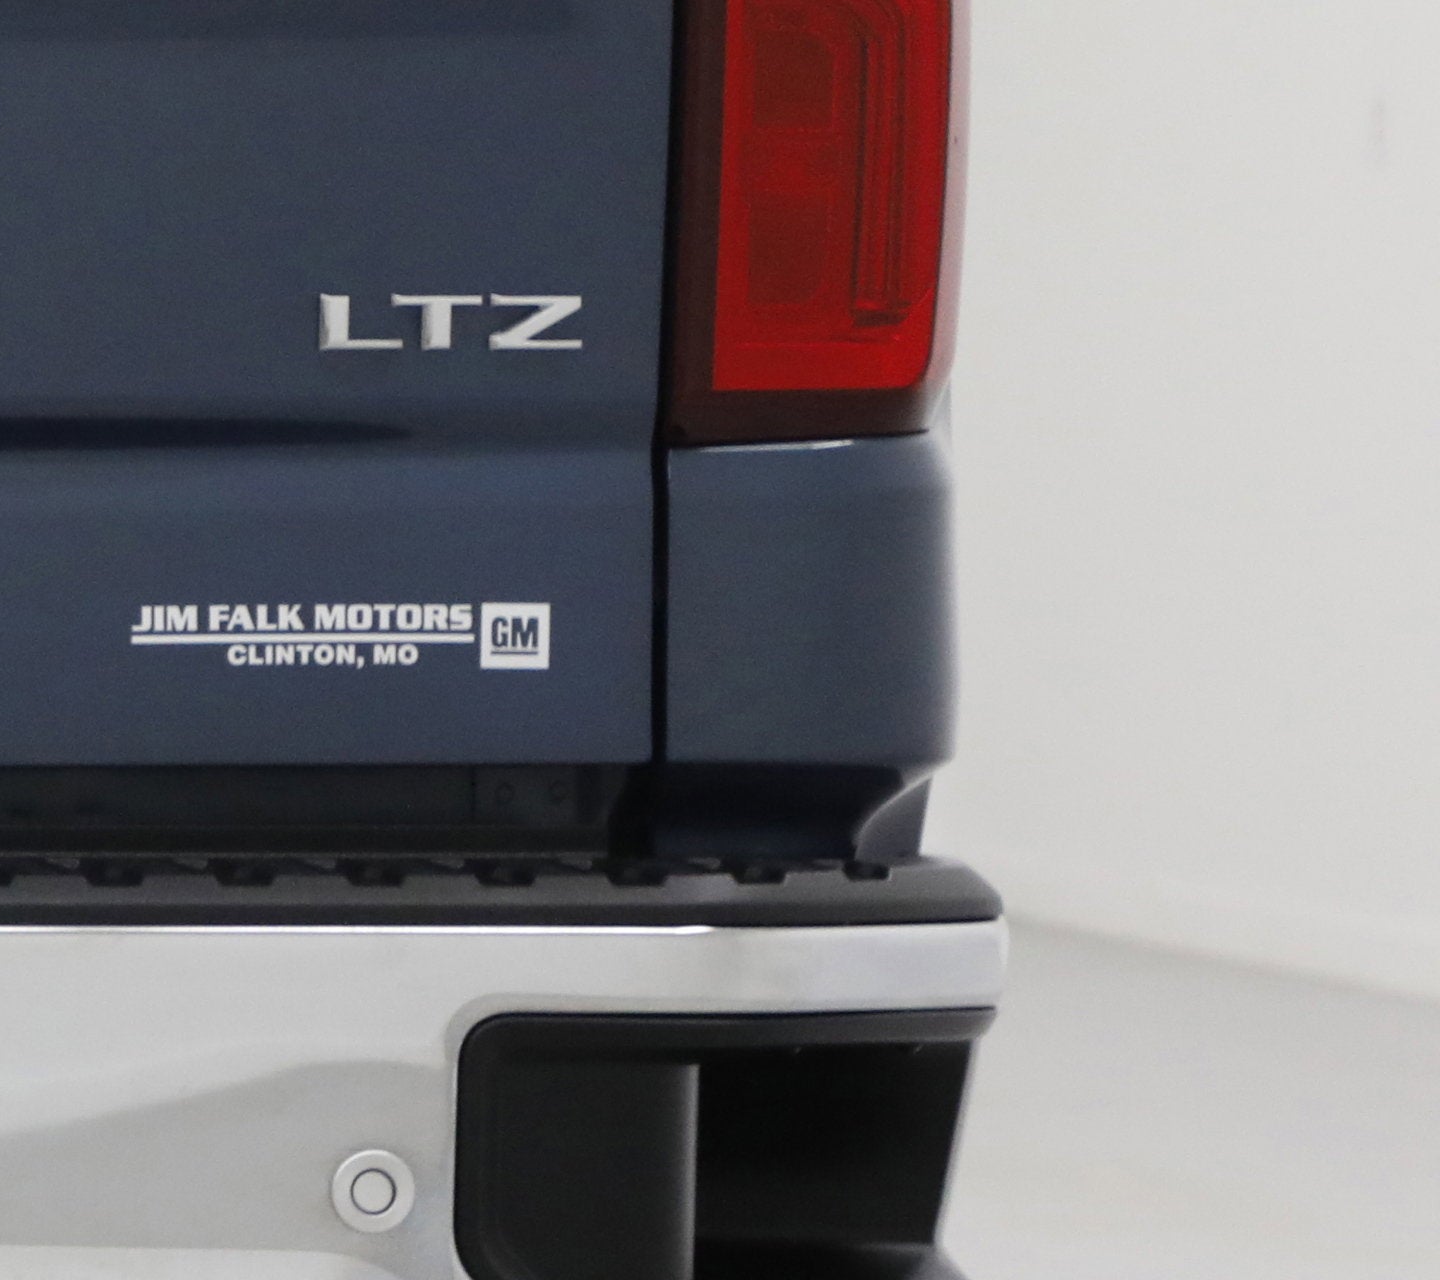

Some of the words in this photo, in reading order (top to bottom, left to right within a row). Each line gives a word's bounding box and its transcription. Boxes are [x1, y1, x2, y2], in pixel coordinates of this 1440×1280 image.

[318, 293, 583, 351] LTZ
[132, 605, 198, 632] JIM
[209, 604, 304, 631] FALK
[314, 603, 473, 631] MOTORS
[491, 616, 538, 648] GM
[227, 644, 365, 668] CLINTON,
[373, 644, 419, 665] MO
